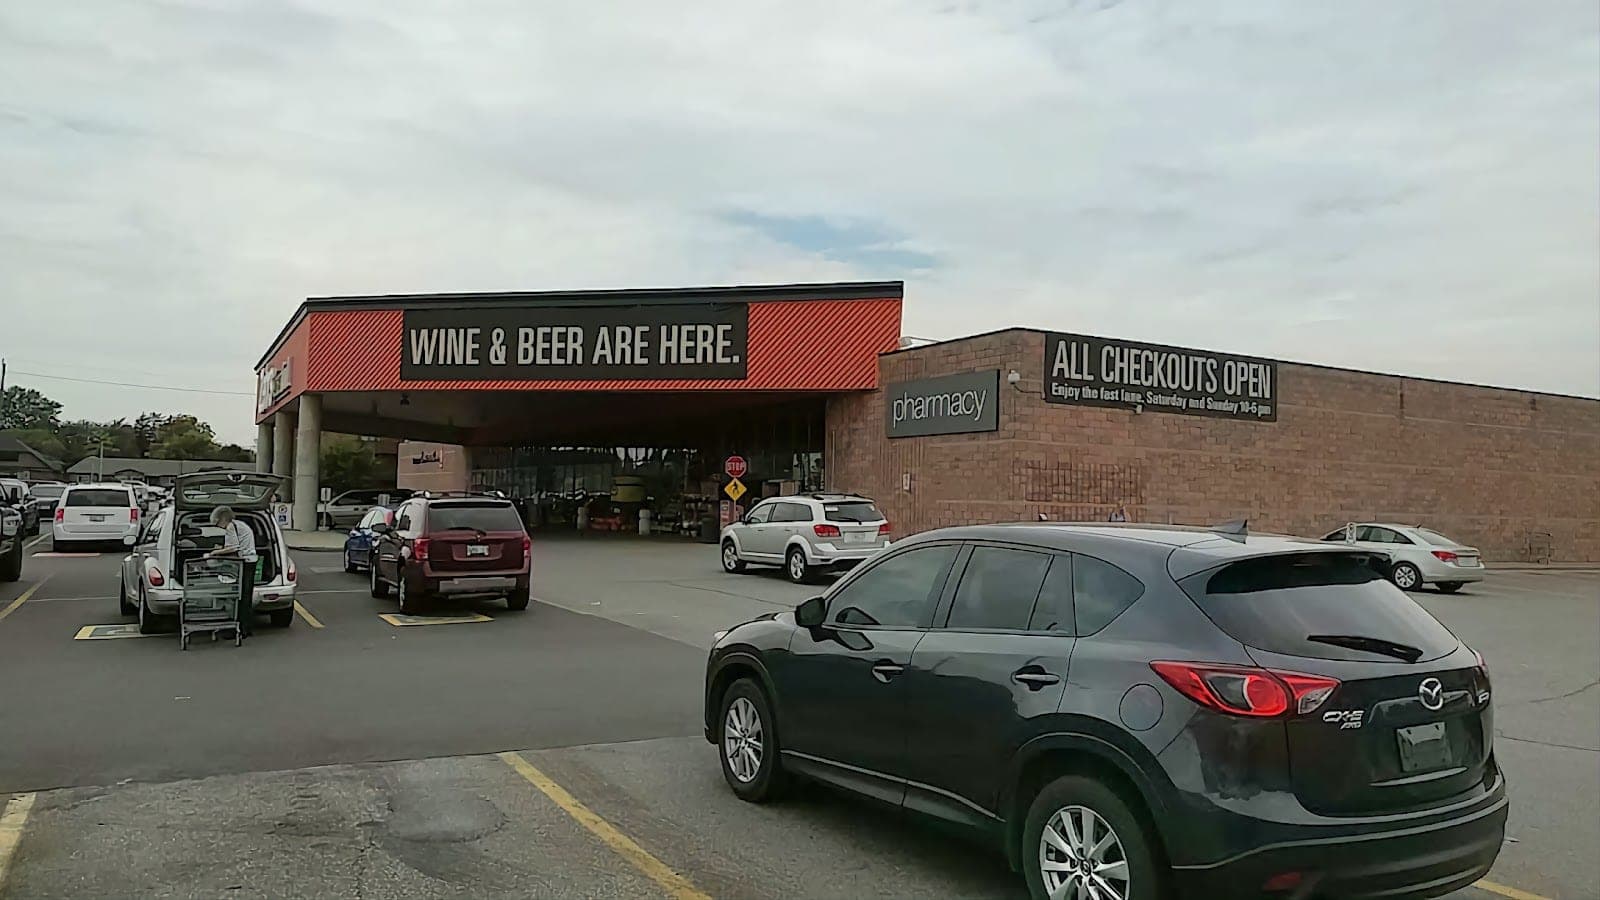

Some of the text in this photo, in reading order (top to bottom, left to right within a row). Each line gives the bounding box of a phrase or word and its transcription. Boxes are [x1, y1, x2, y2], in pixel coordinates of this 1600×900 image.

[410, 324, 739, 365] WINE & BEER ARE HERE.
[1052, 340, 1271, 398] ALL CHECKOUTS OPEN
[893, 389, 987, 429] pharmacy
[1052, 382, 1080, 400] Enjoy
[1082, 386, 1098, 399] the
[1100, 387, 1119, 400] fast
[1146, 392, 1187, 409] Saturday
[1189, 397, 1205, 409] and
[1207, 398, 1238, 414] Sunday
[728, 462, 744, 470] STOP
